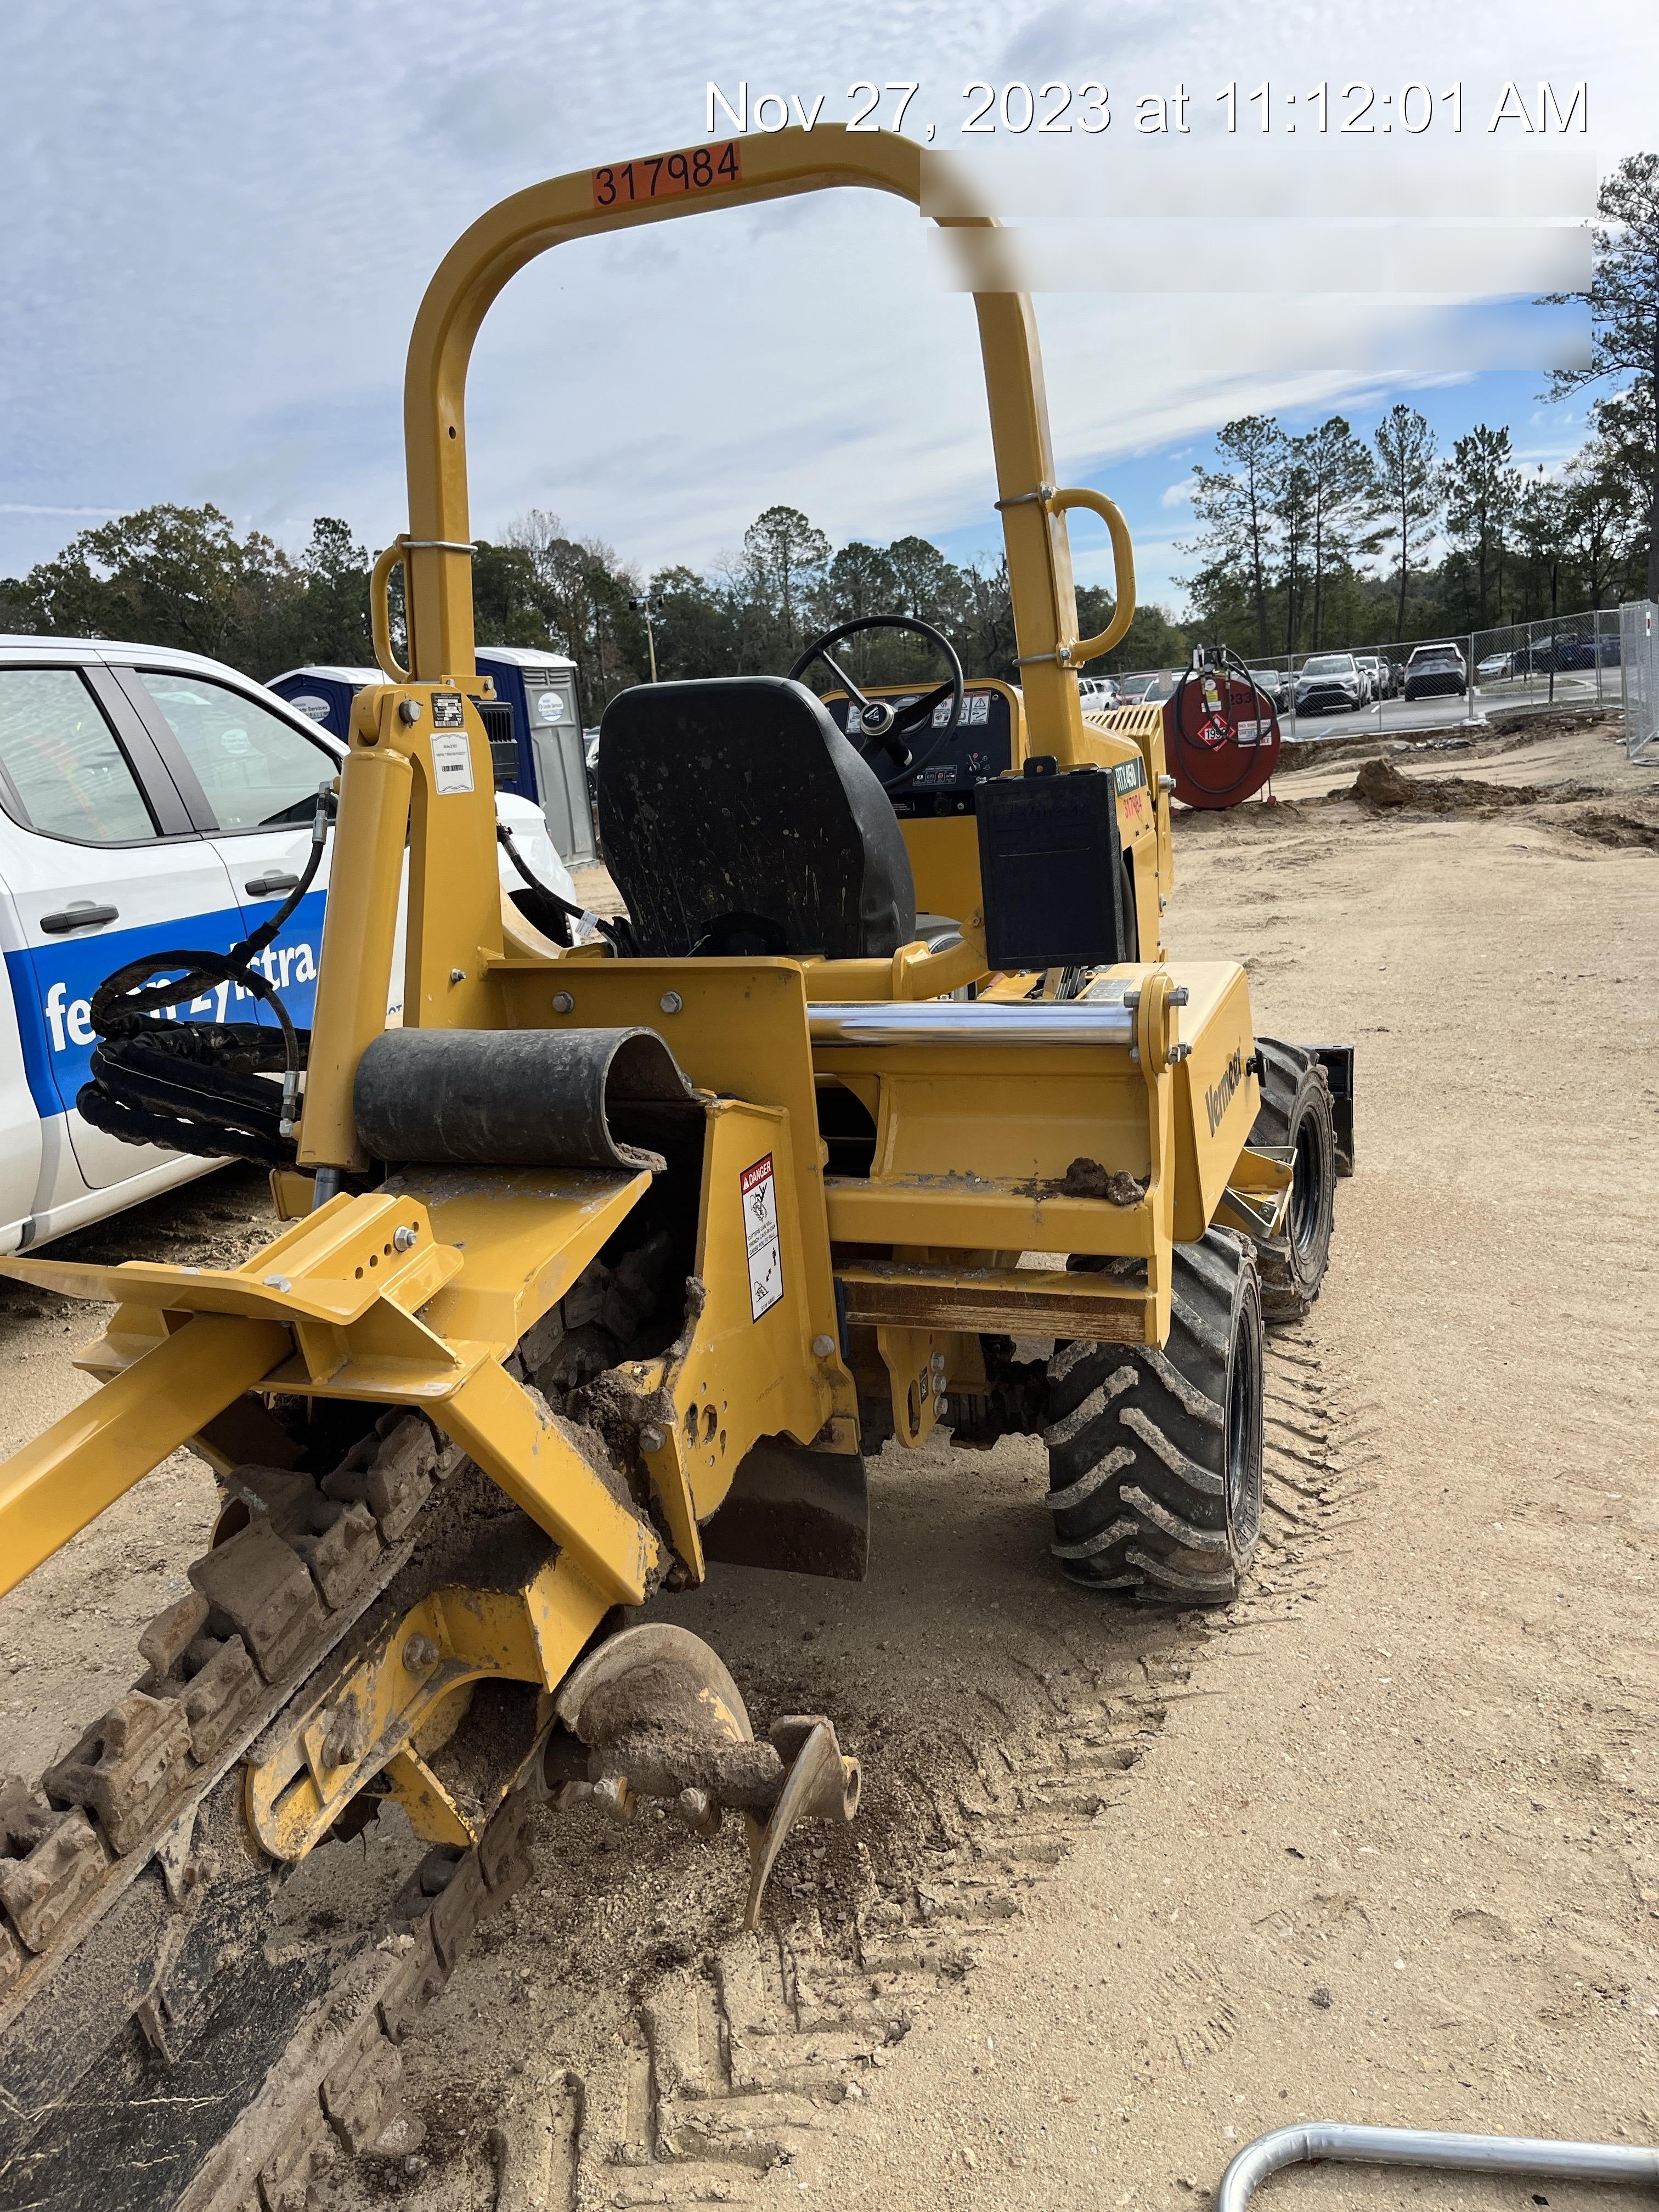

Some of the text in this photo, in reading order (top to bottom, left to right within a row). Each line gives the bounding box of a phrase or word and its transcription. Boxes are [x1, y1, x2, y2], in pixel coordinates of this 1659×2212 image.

[596, 143, 739, 205] 317984
[1205, 1045, 1242, 1138] Vermeer
[748, 1161, 771, 1188] DANGER
